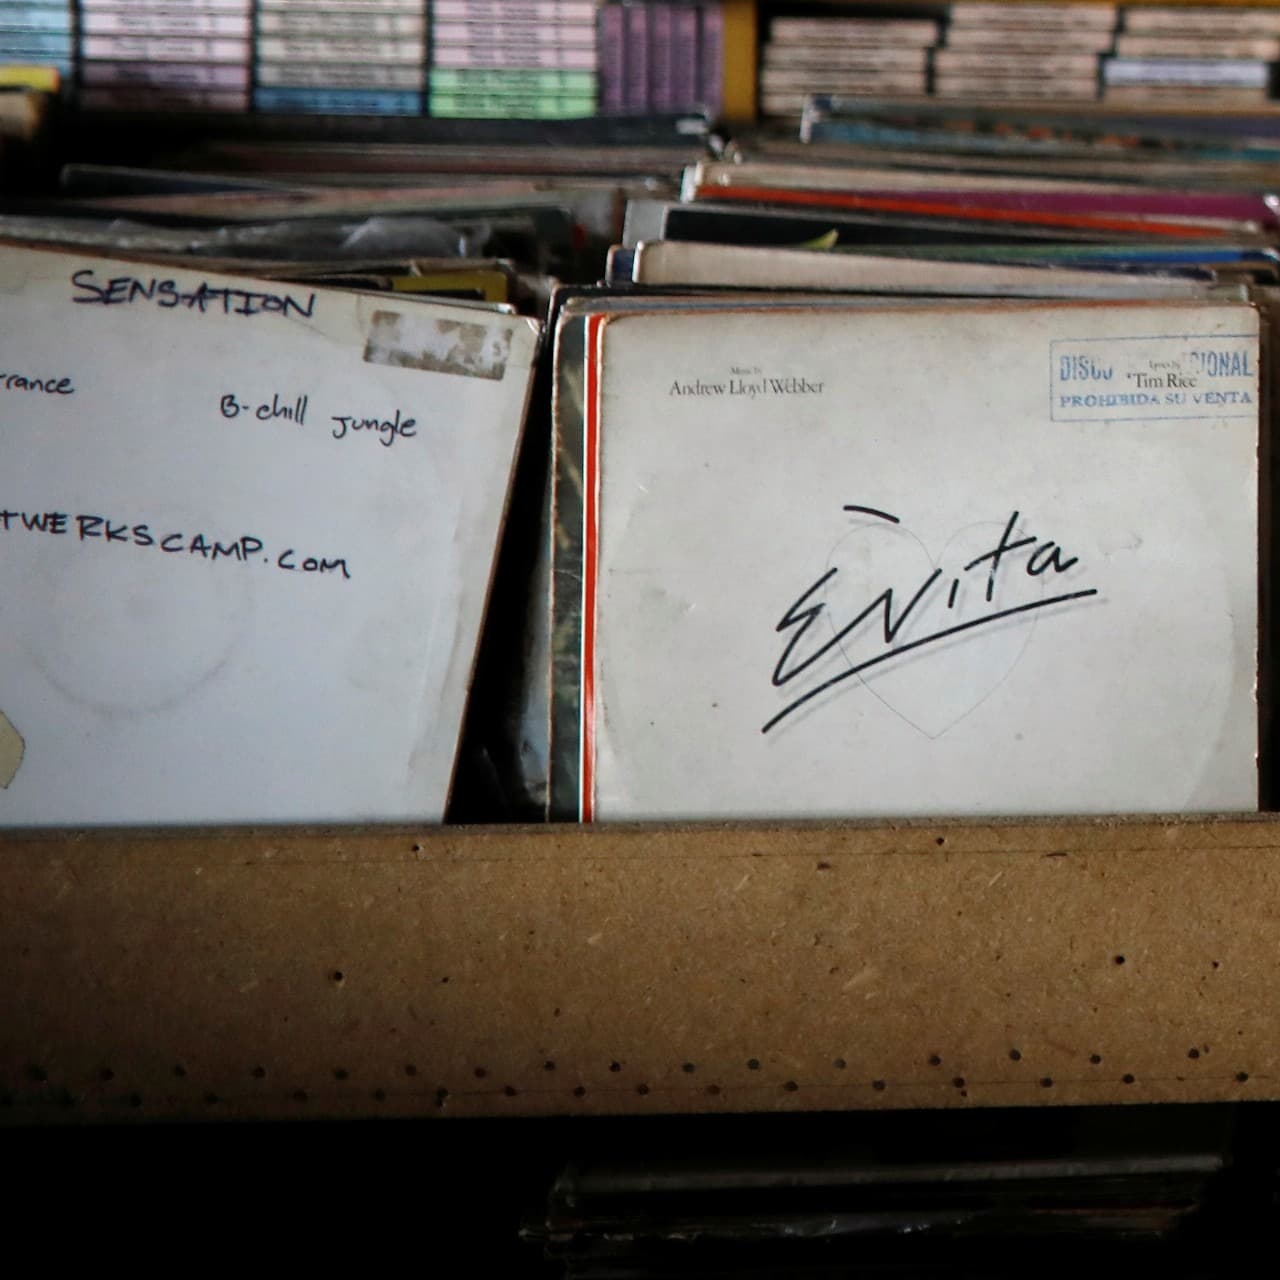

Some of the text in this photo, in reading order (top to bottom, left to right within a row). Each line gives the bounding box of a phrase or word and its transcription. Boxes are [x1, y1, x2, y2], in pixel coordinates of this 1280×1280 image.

[72, 269, 316, 319] SENSATION
[0, 373, 75, 395] rance
[669, 378, 825, 400] Andrew Lloyd Webber
[1133, 372, 1198, 388] Tim Rice
[1060, 390, 1254, 409] PROHIBIDA SU VENTA
